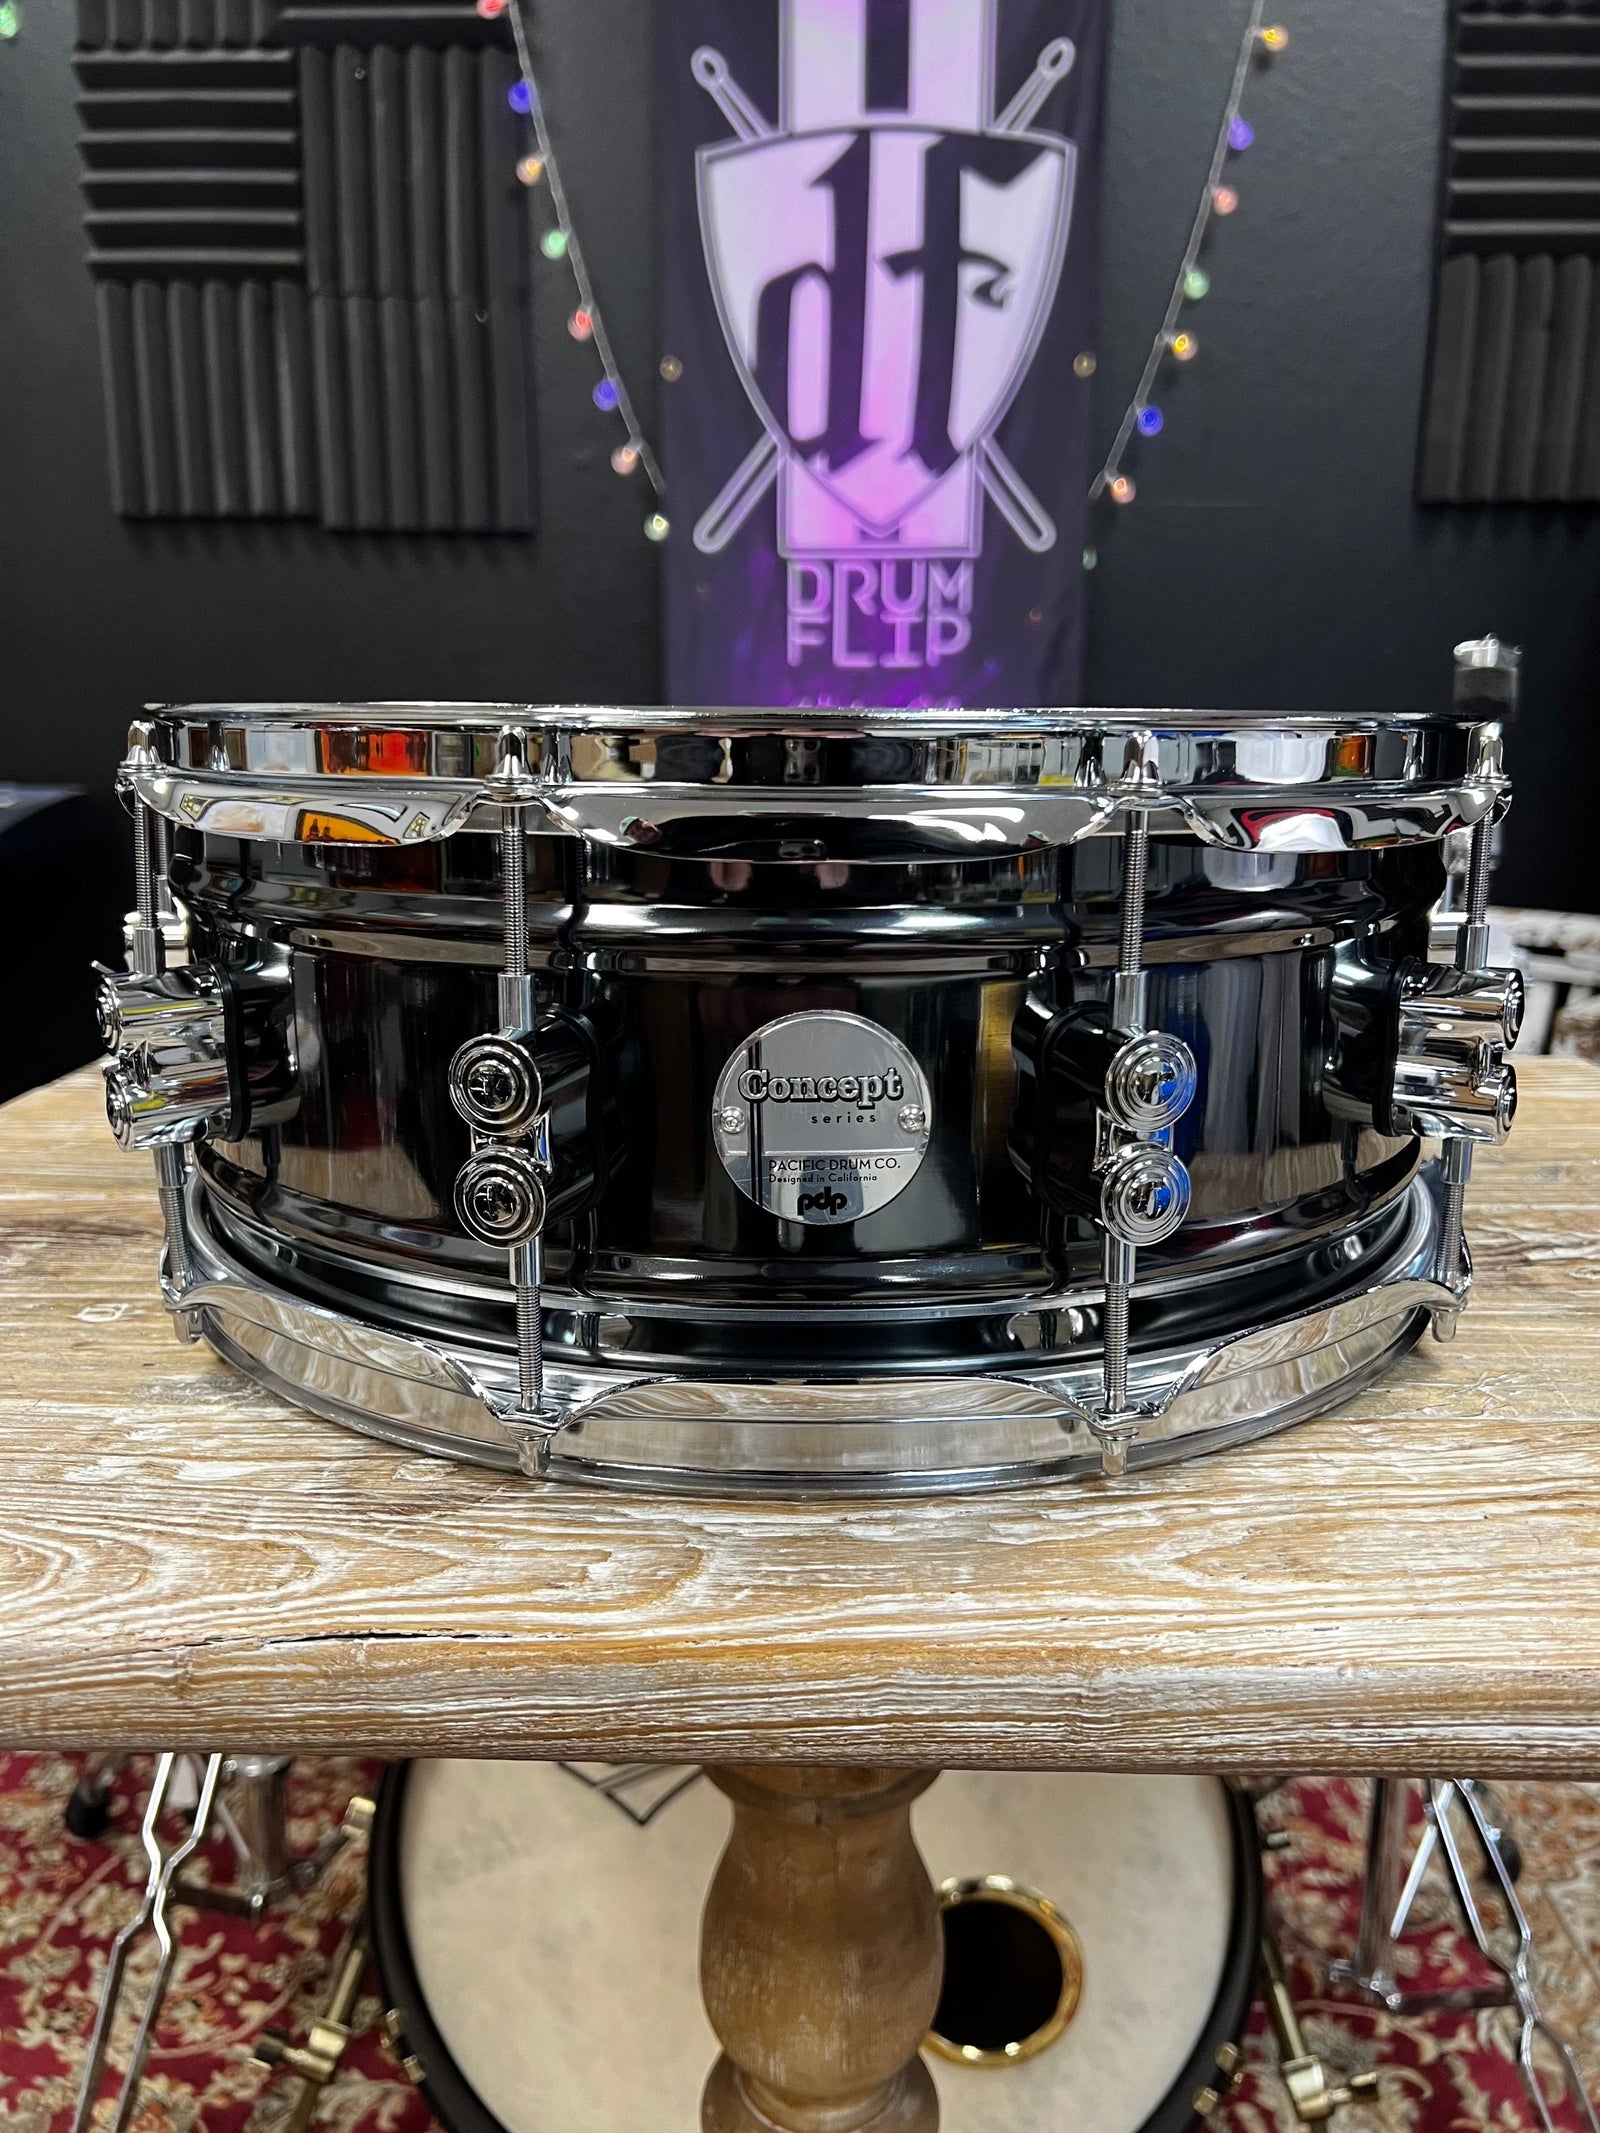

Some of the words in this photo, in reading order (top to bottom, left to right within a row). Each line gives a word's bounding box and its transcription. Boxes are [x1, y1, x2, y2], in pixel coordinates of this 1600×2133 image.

[787, 558, 974, 616] DRUM
[786, 613, 972, 668] FLIP
[738, 1067, 904, 1110] Concept
[811, 1111, 876, 1124] series
[768, 1159, 826, 1172] PACIFIC
[829, 1158, 871, 1171] DRUM
[874, 1157, 901, 1170] CO.
[768, 1173, 814, 1185] Designed
[816, 1173, 825, 1183] in
[828, 1172, 877, 1183] California
[797, 1186, 848, 1216] pdp
